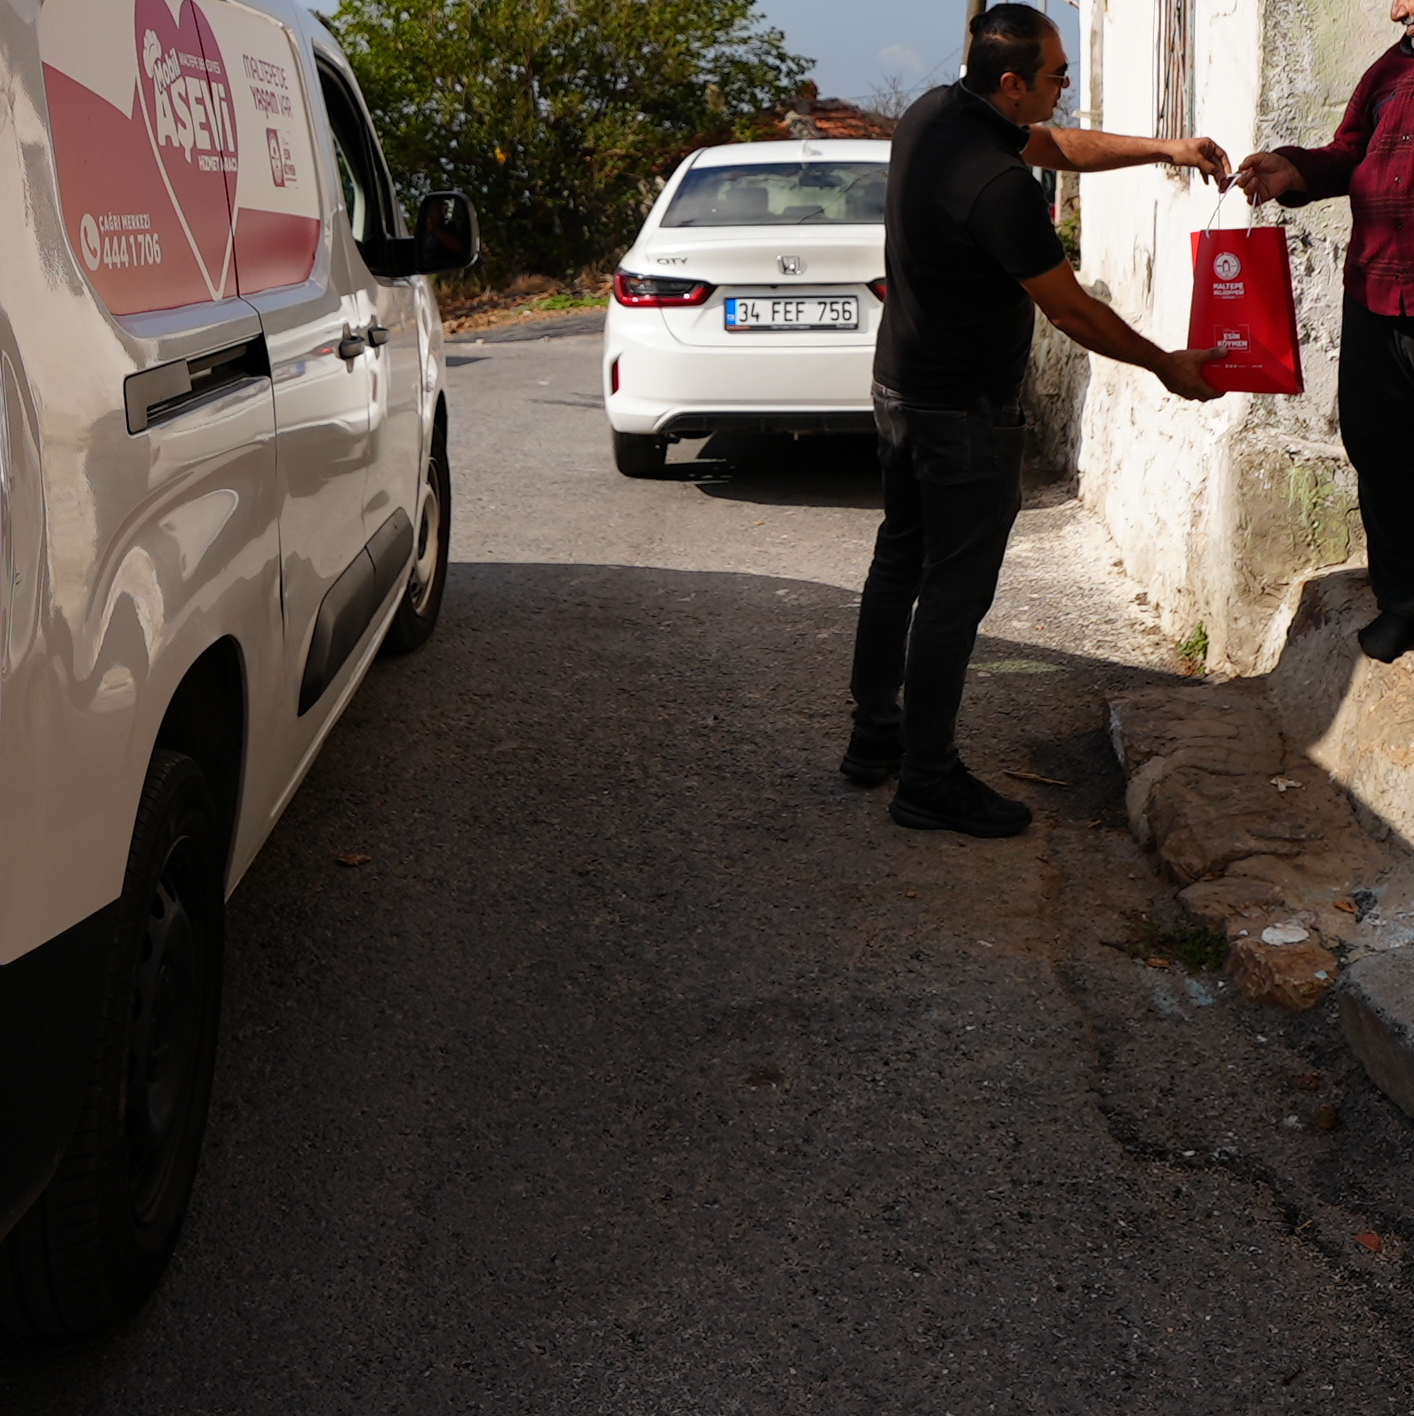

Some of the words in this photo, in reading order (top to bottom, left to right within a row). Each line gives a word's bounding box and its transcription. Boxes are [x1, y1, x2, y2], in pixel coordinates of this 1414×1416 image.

[153, 47, 181, 95] Mobil
[738, 302, 760, 322] 34
[771, 301, 805, 322] FEF
[817, 301, 852, 321] 756
